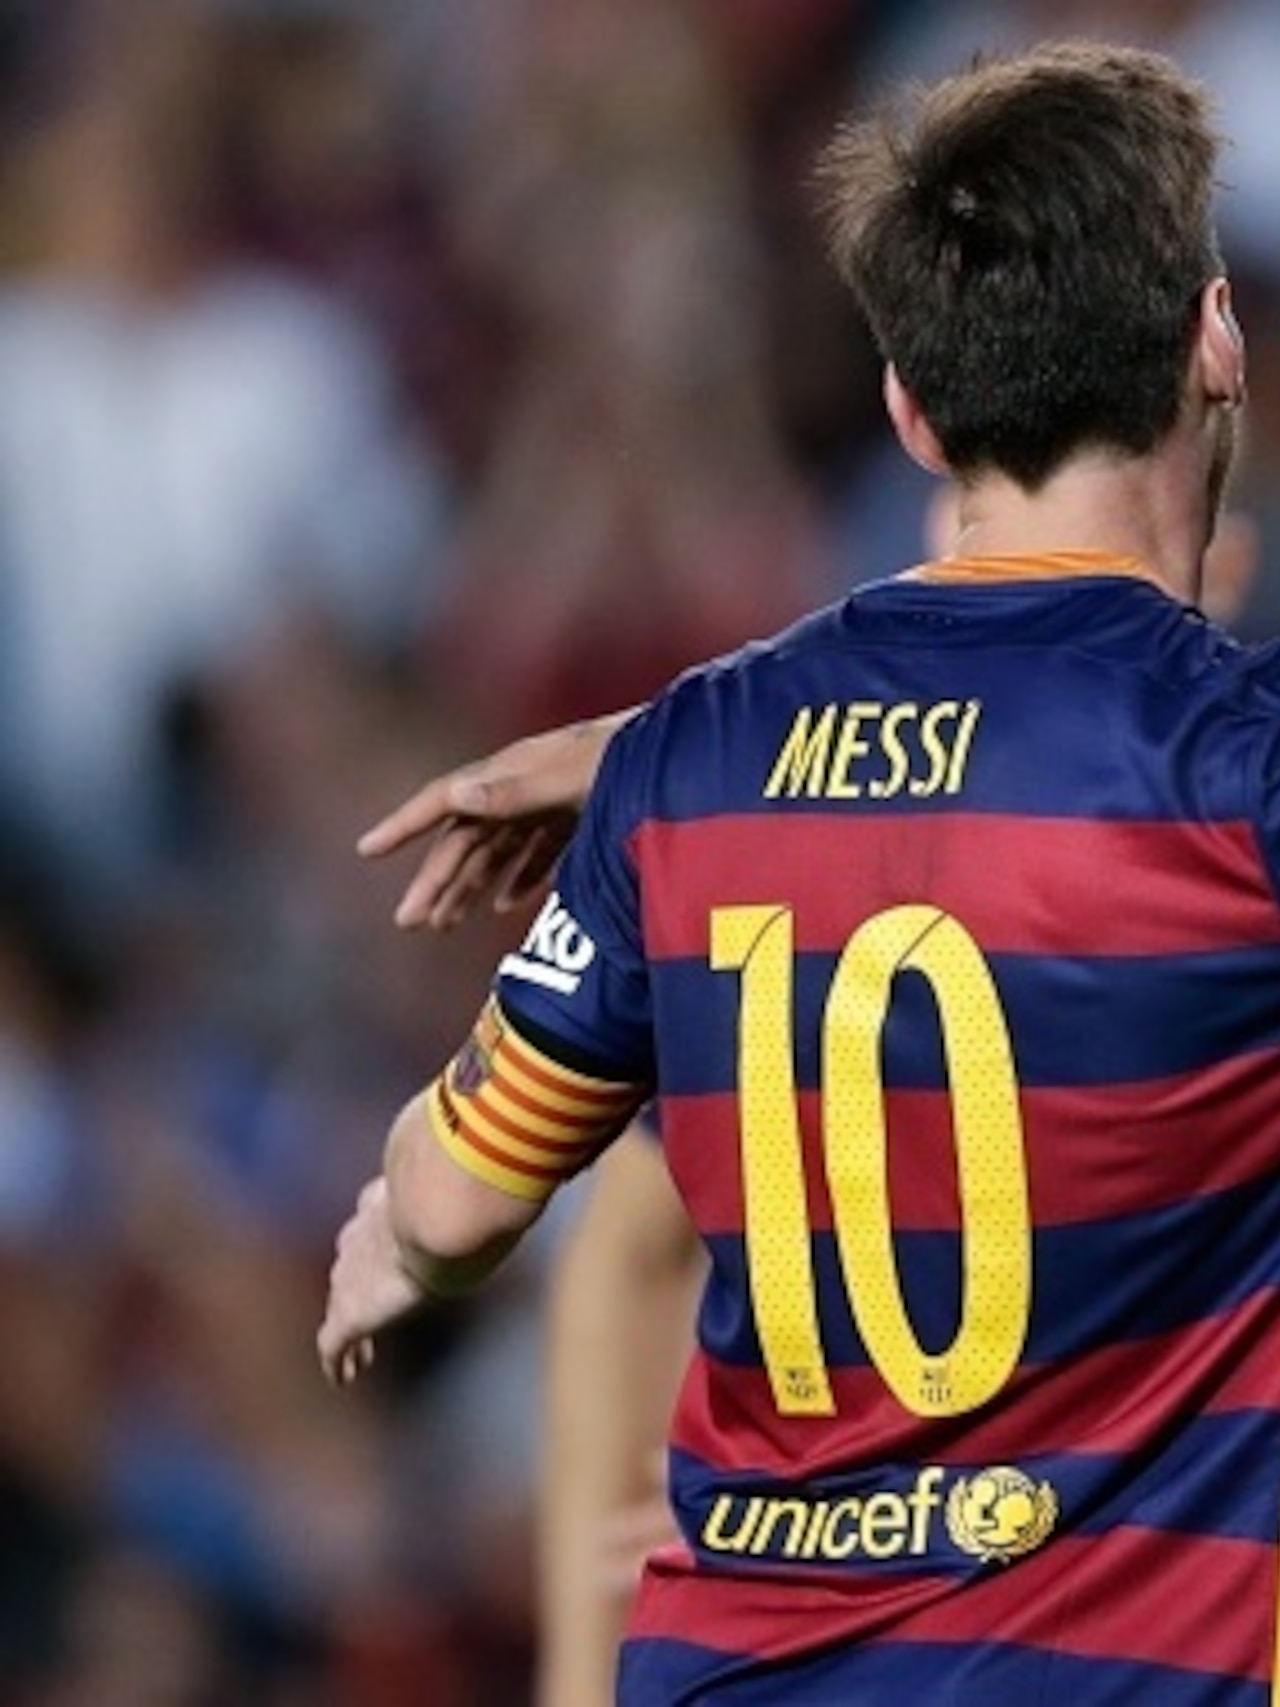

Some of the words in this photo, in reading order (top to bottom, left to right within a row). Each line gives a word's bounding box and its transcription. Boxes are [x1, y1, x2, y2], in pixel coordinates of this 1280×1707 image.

[763, 699, 981, 798] MESSI
[709, 904, 1032, 1418] 10
[701, 1467, 945, 1560] unicef
